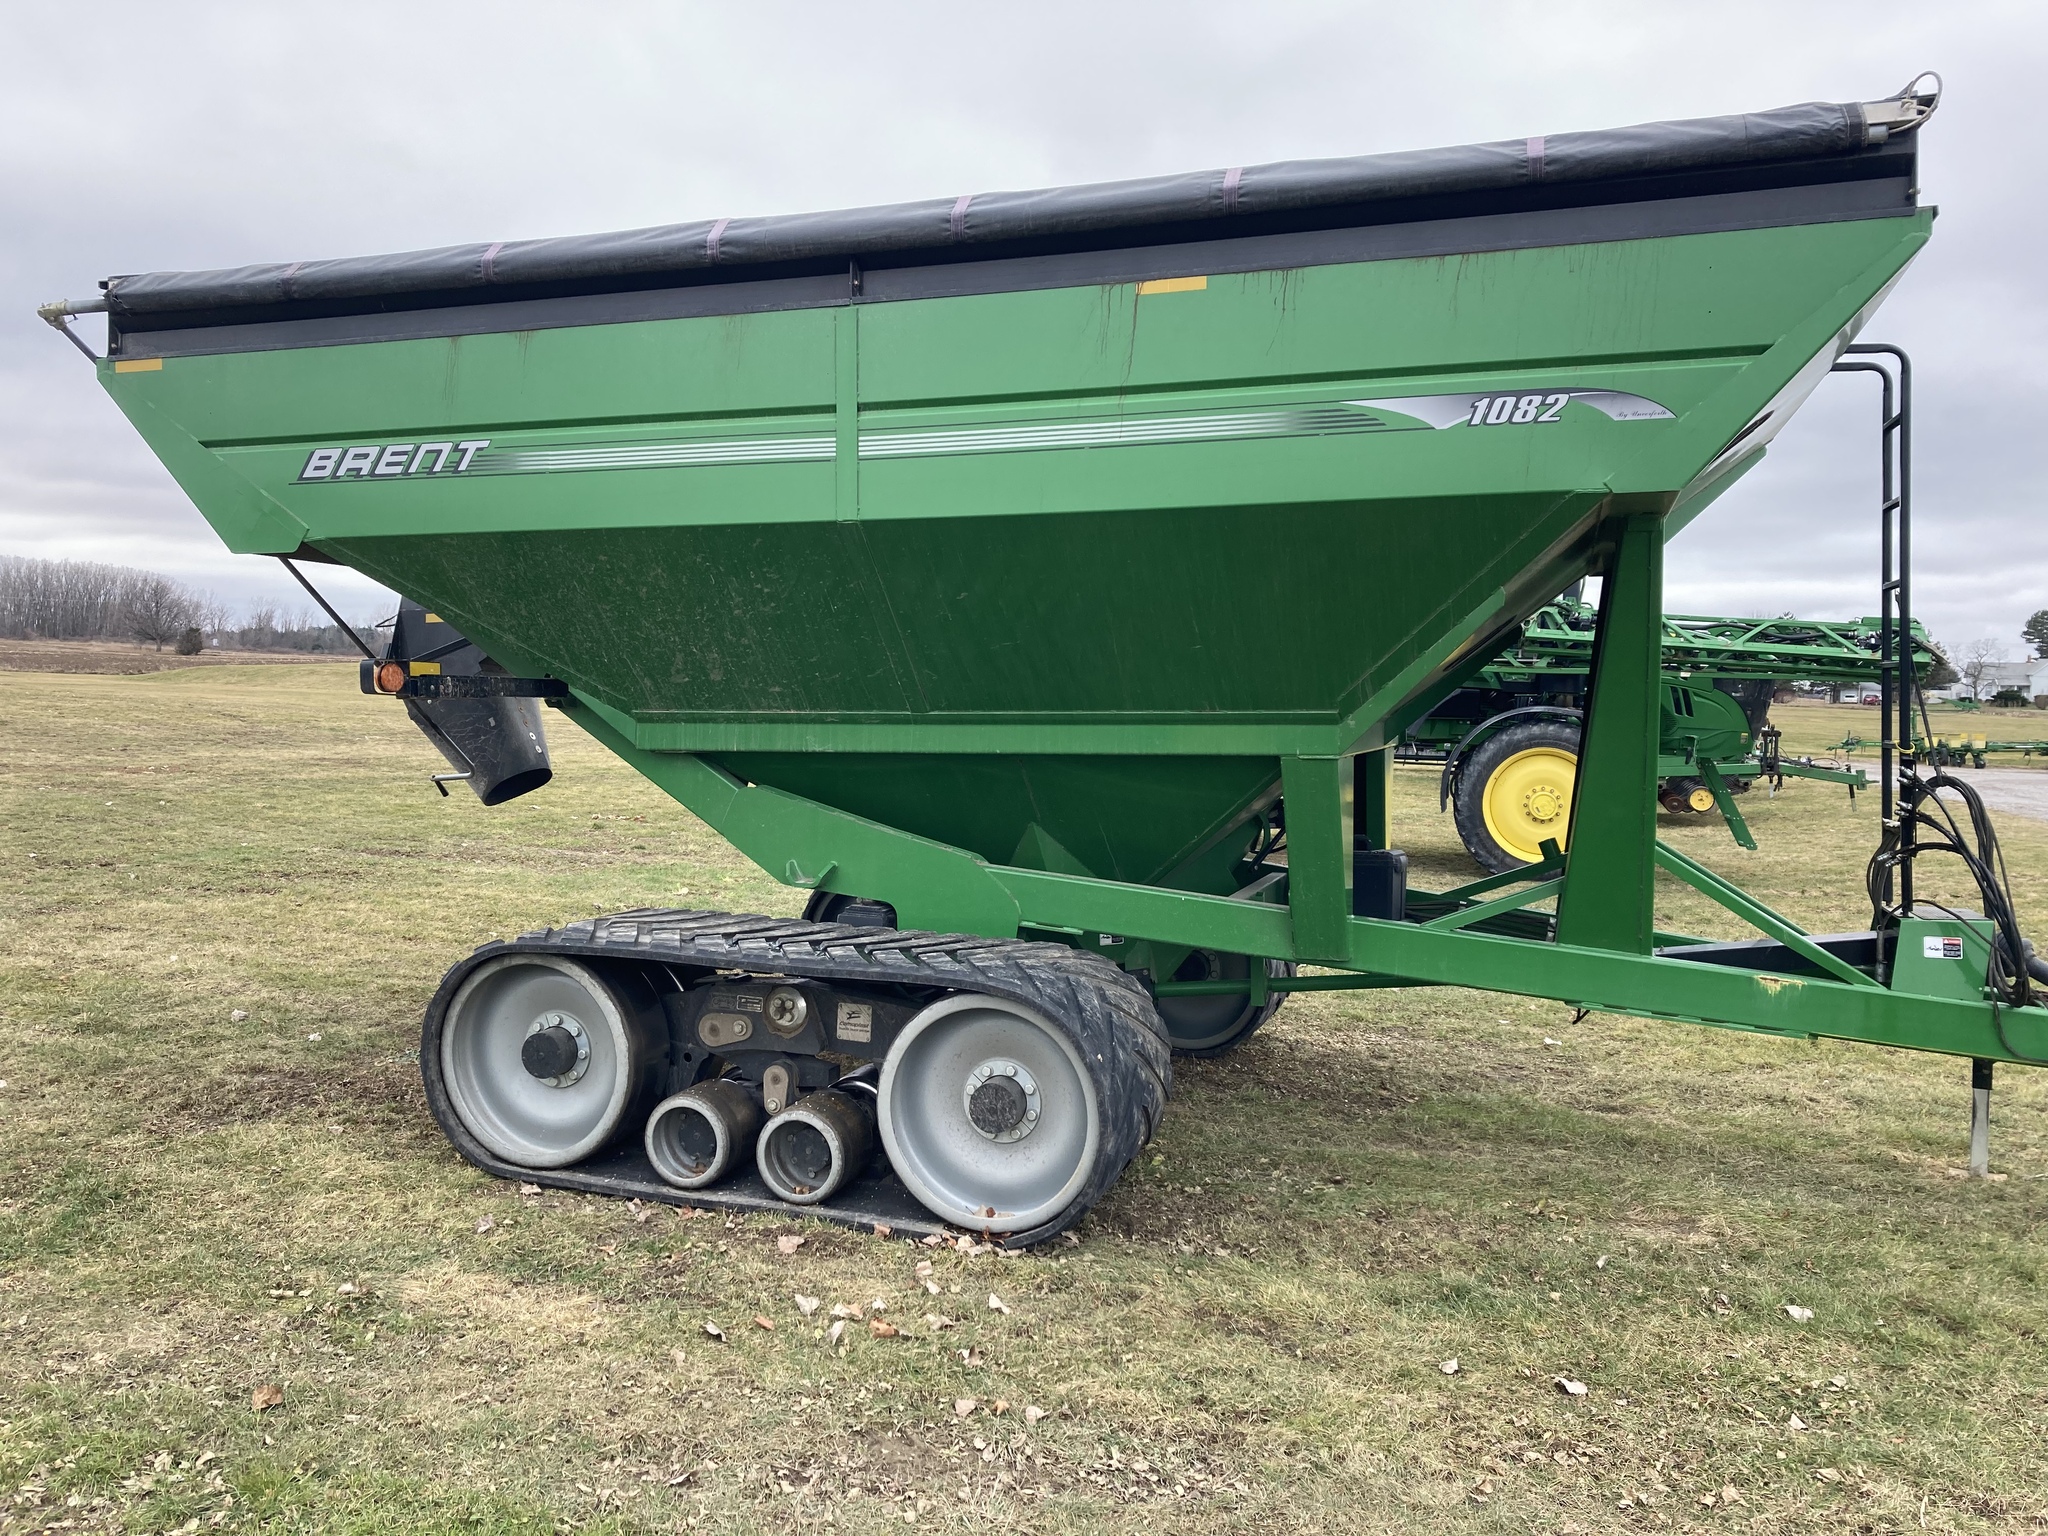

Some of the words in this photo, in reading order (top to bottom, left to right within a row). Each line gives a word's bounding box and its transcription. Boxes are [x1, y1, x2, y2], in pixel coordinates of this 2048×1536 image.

[1467, 393, 1570, 427] 1082
[1616, 411, 1628, 419] By
[297, 439, 492, 481] BRENT
